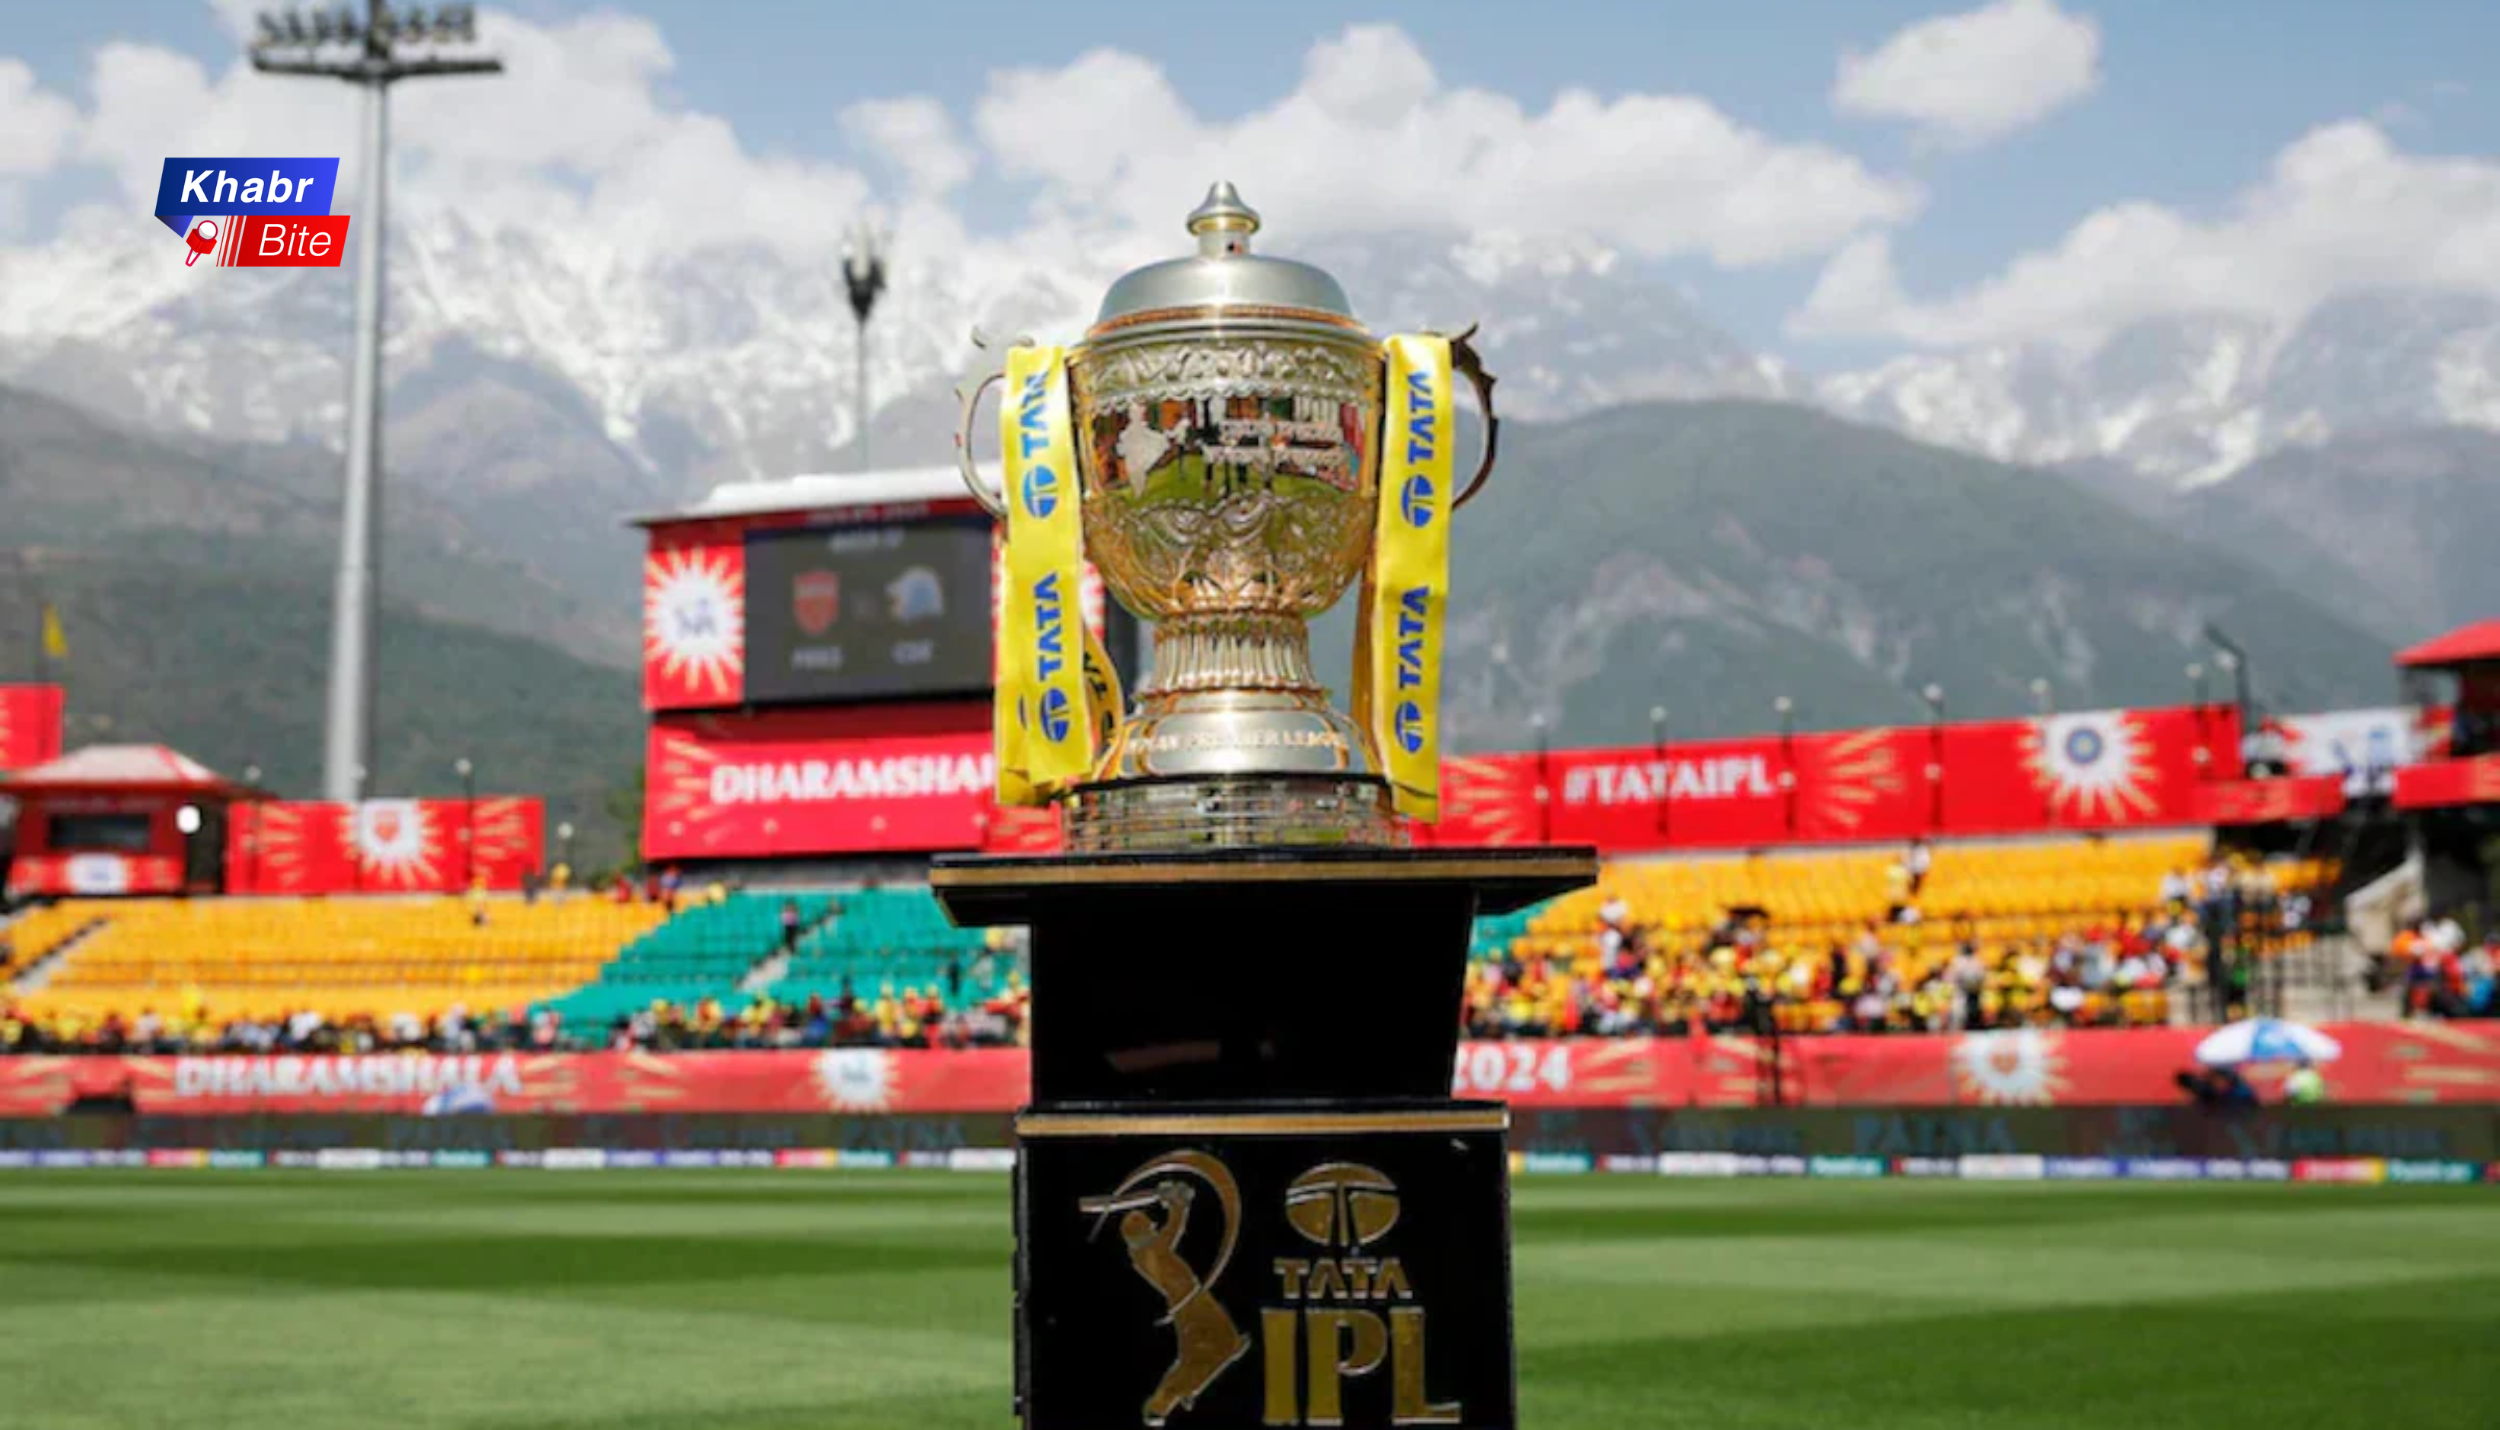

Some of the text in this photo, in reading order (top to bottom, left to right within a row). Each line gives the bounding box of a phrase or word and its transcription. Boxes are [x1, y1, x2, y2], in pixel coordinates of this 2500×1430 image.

[1407, 371, 1435, 464] TATA
[1034, 572, 1063, 681] TATA
[1398, 586, 1430, 689] TATA
[1564, 755, 1775, 805] #TATAIPL
[176, 1055, 523, 1096] DHARAMSHALA
[1274, 1258, 1413, 1298] TATA
[1260, 1307, 1461, 1425] IPL
